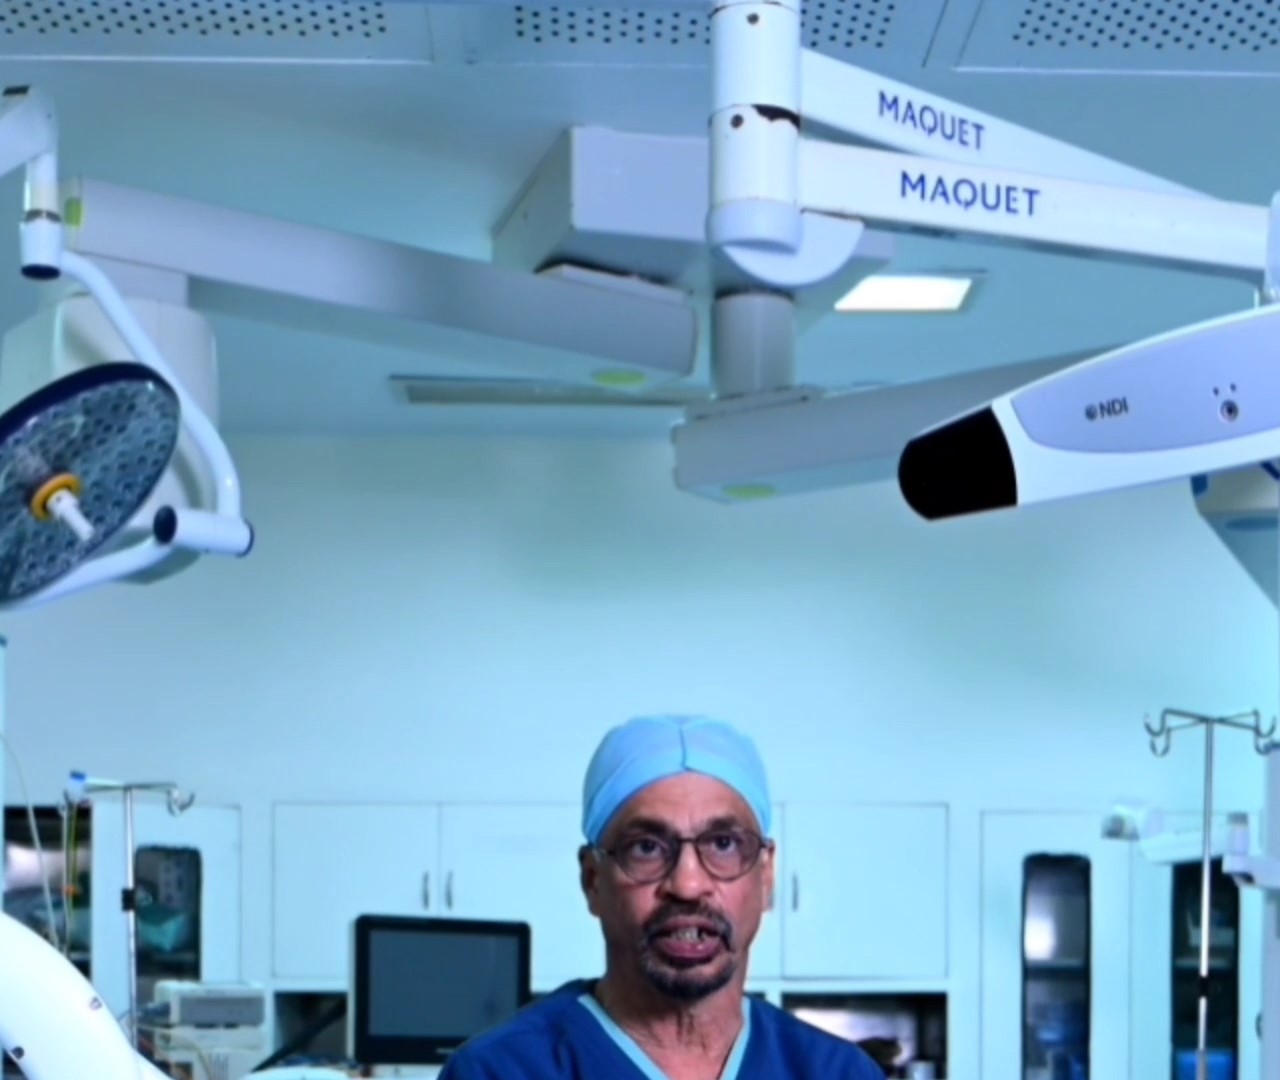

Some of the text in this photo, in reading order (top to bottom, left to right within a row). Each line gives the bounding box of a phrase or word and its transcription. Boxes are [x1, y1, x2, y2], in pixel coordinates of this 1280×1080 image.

[878, 90, 985, 149] MAQUET
[900, 170, 1040, 216] MAQUET
[1099, 396, 1129, 420] NDI
